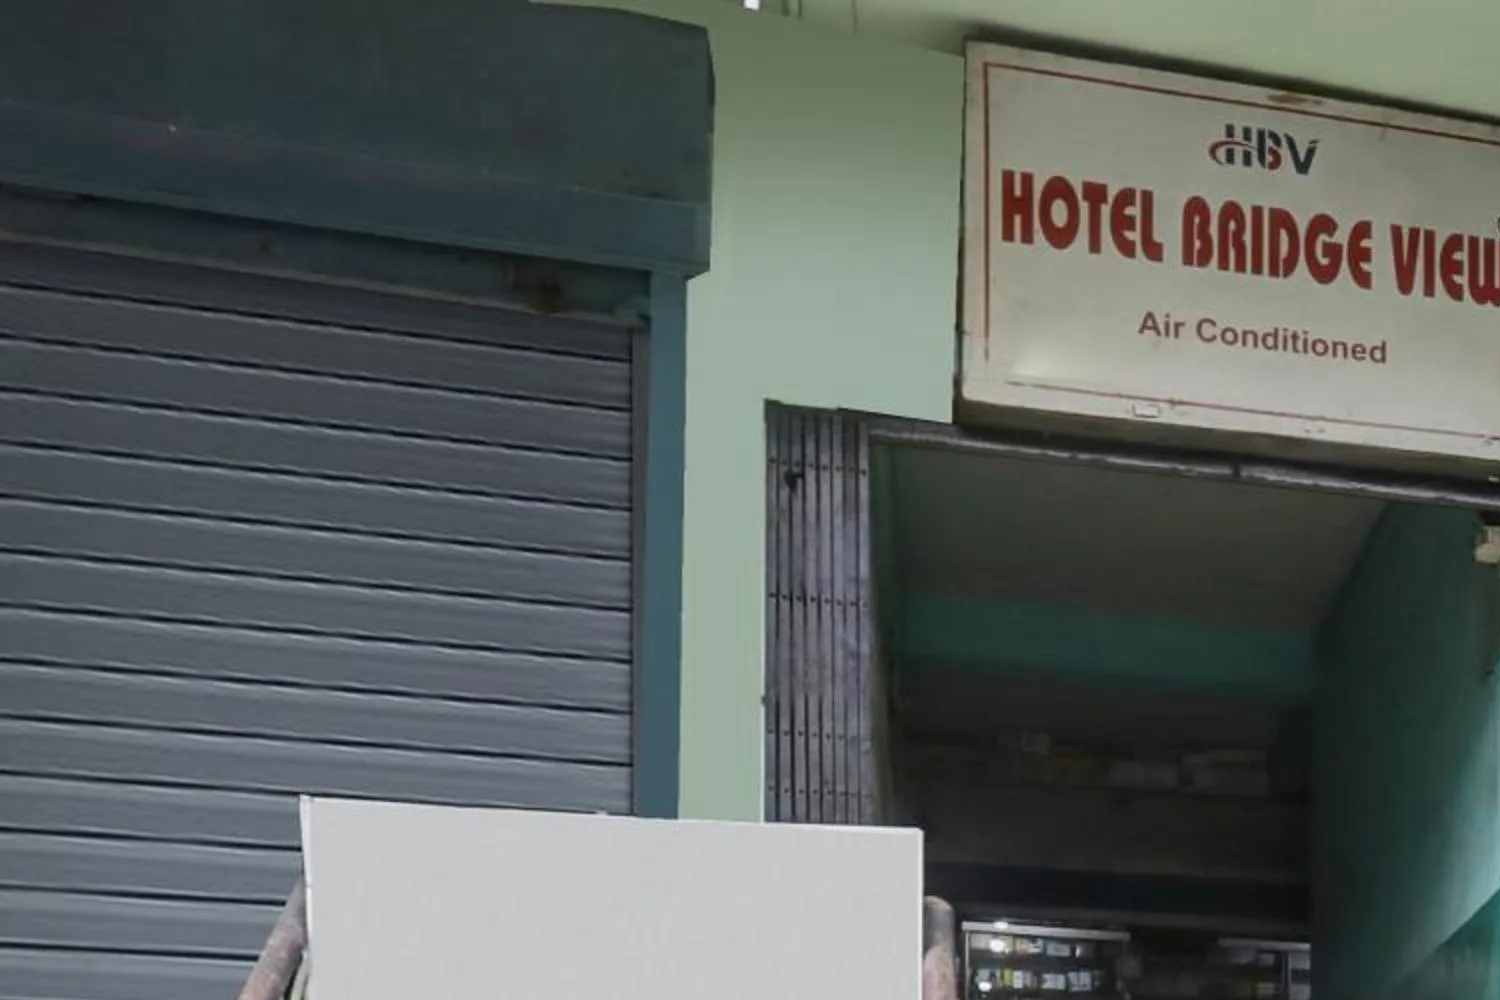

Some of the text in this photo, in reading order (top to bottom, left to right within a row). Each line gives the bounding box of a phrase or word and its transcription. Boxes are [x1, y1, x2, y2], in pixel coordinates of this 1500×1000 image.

[1208, 123, 1321, 176] HBV
[1001, 169, 1164, 263] HOTEL
[1181, 195, 1373, 290] BRIDGE
[1137, 311, 1387, 364] Air Conditioned
